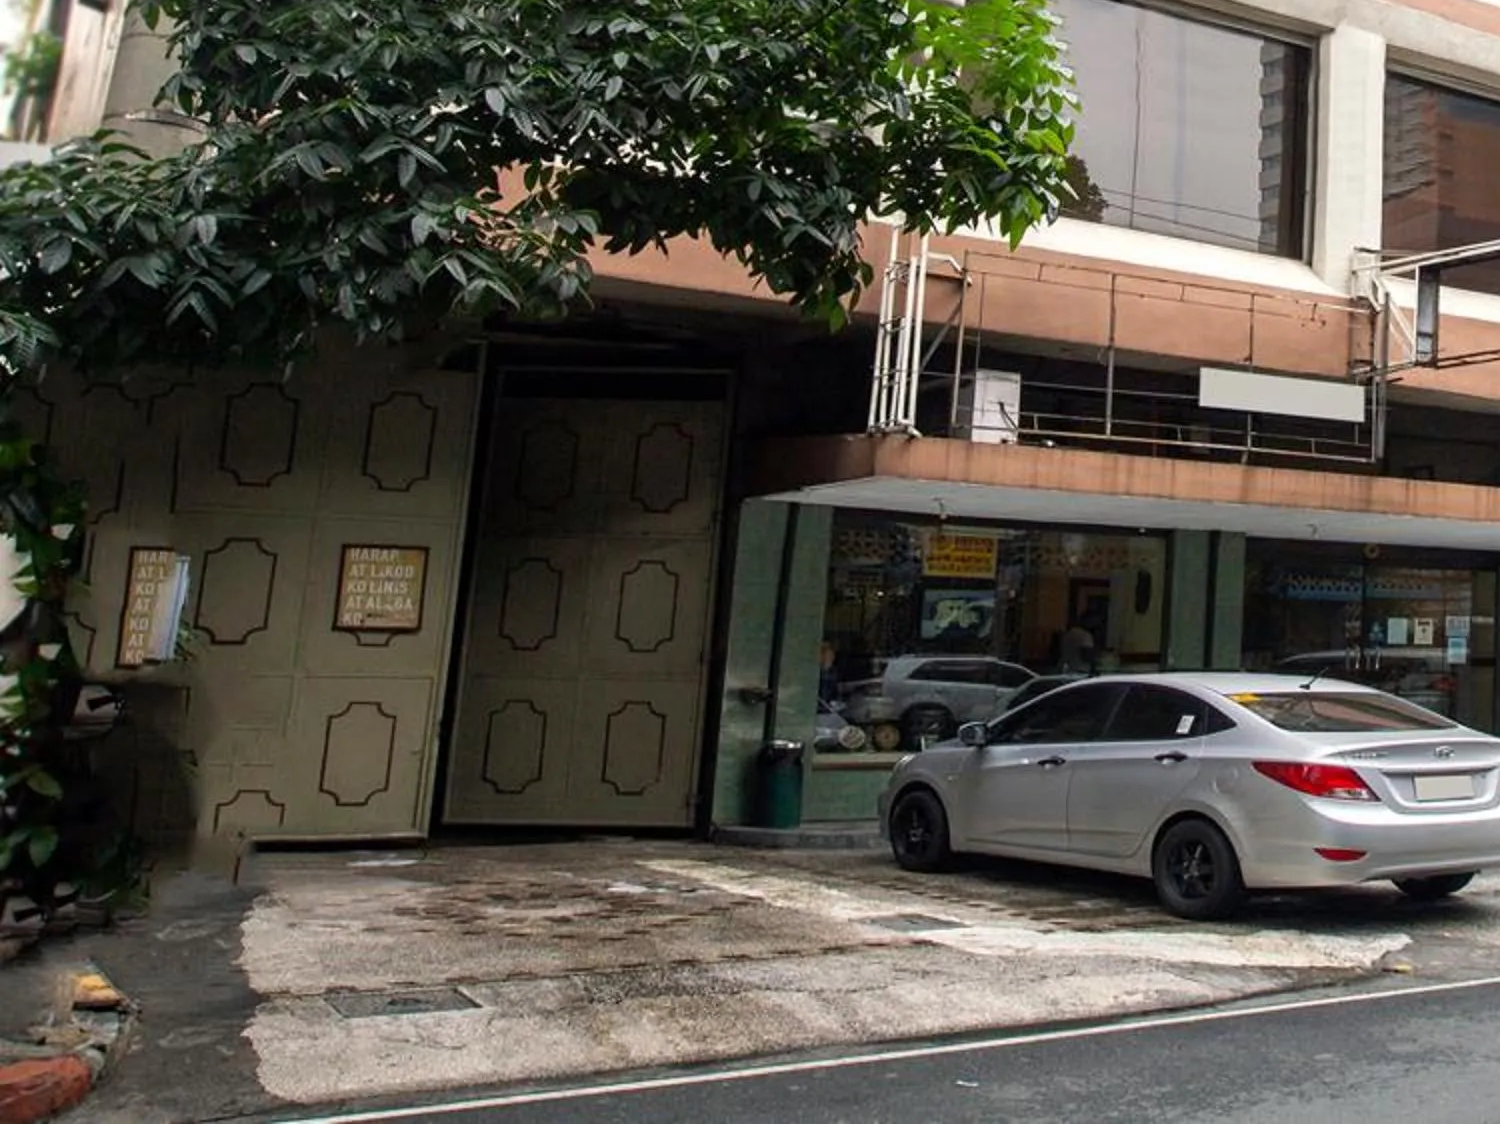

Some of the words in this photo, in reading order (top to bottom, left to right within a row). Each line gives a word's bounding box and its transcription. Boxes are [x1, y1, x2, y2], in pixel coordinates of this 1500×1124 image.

[349, 563, 366, 577] AT
[347, 580, 366, 593] KO
[345, 595, 363, 609] AT
[128, 633, 144, 647] AT
